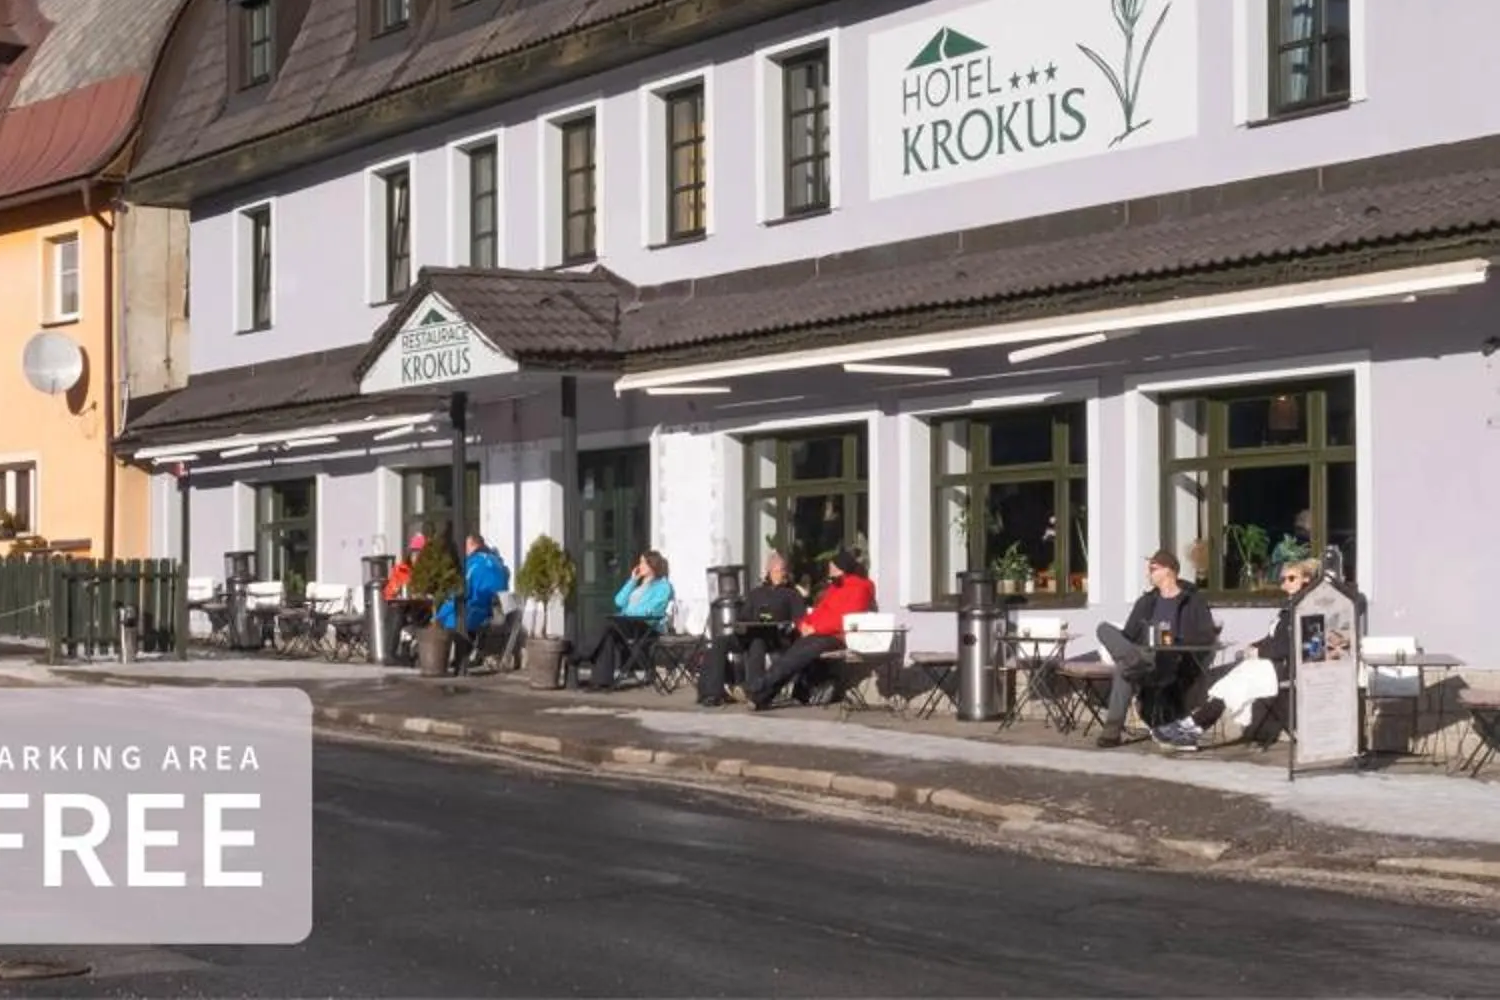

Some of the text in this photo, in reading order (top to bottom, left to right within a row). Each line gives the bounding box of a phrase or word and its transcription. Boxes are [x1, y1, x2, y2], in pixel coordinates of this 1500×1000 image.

[902, 55, 1002, 116] HOTEL
[902, 87, 1087, 176] KROKUS
[402, 347, 471, 384] KROKUS
